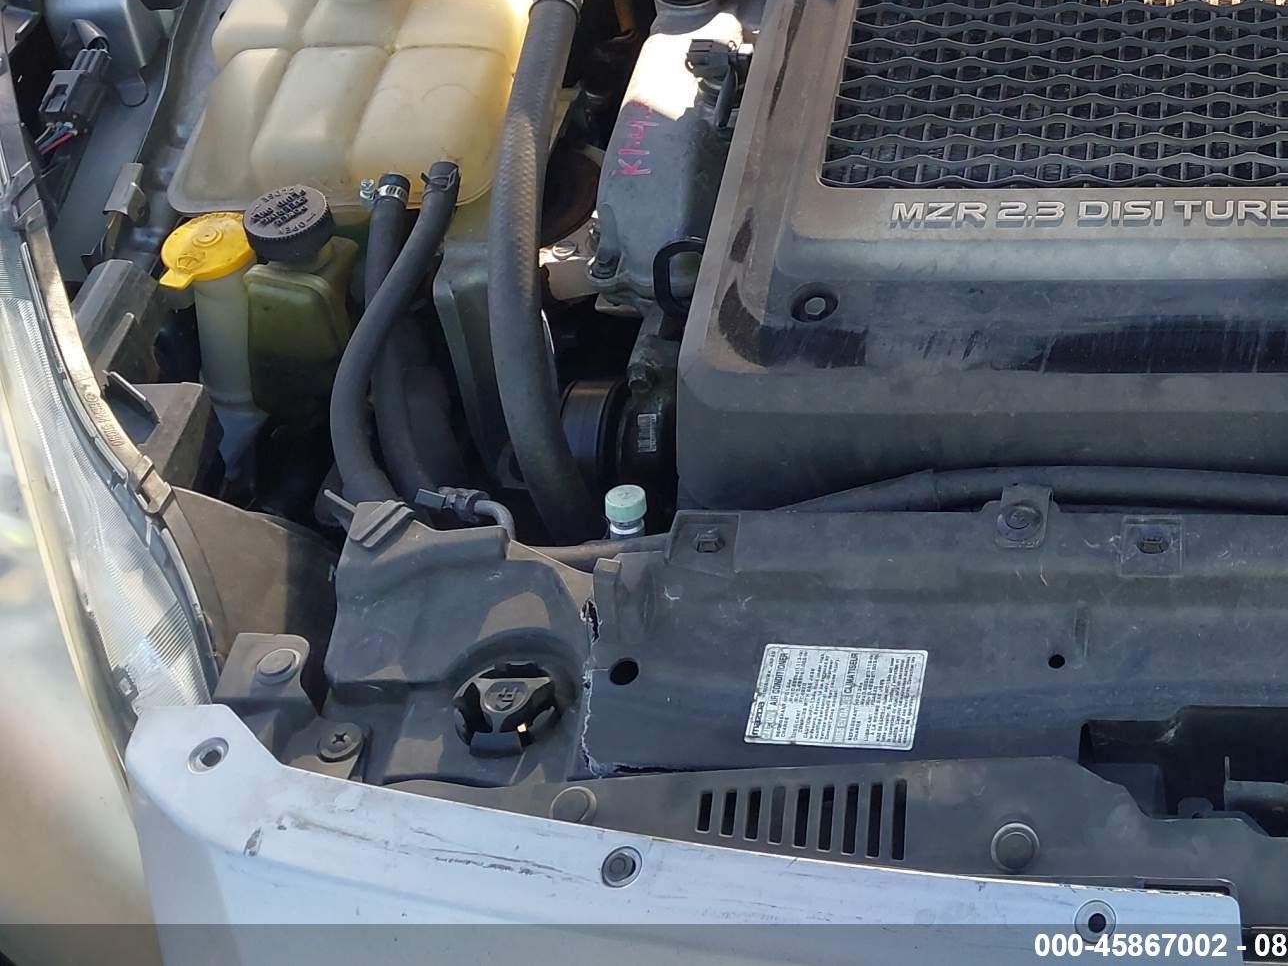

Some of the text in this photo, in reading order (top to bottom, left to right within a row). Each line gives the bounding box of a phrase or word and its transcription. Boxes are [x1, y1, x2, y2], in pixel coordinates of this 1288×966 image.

[890, 200, 987, 224] MZR
[996, 200, 1066, 224] 2.3
[1076, 199, 1165, 224] DISI
[769, 652, 788, 705] AIR CONDITIONER
[843, 652, 859, 693] CLIMATISEUR
